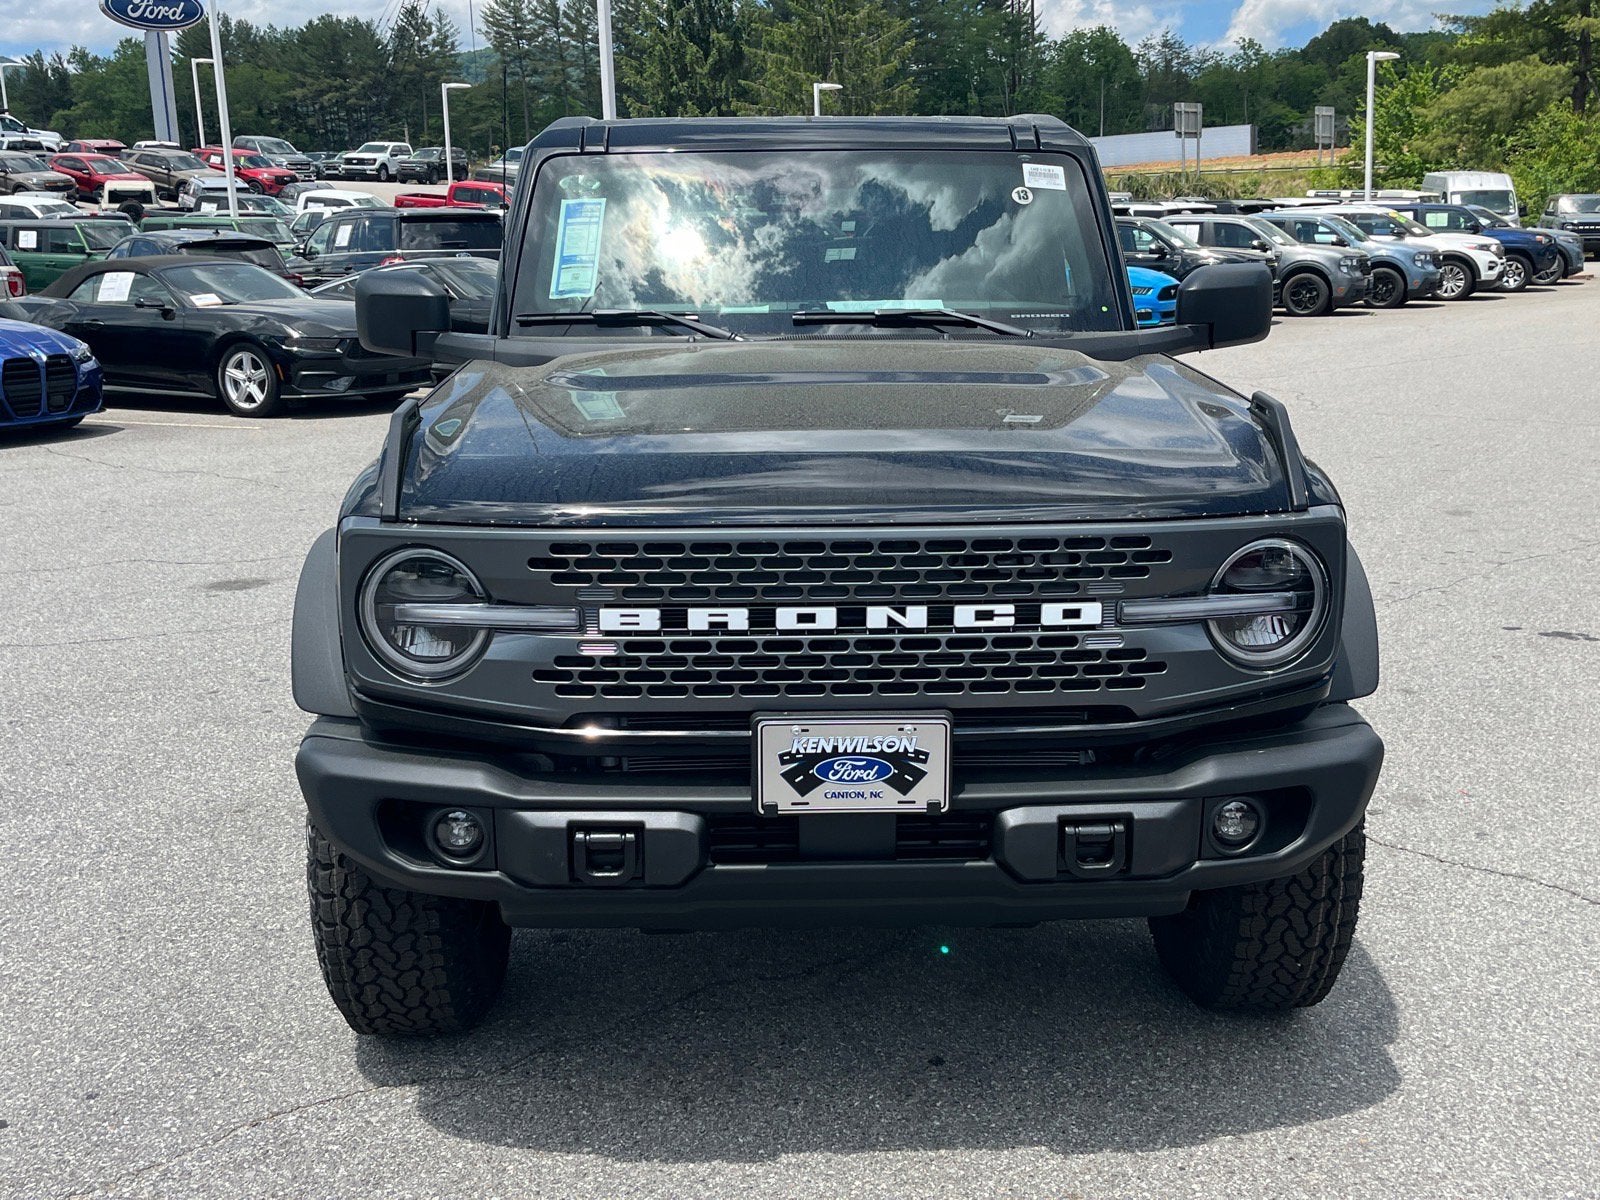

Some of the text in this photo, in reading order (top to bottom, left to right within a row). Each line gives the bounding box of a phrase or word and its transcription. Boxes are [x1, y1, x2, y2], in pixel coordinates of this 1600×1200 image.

[127, 0, 185, 20] Ford
[1015, 190, 1029, 201] 13
[599, 602, 1102, 632] BRONCO
[828, 759, 878, 781] Ford
[824, 790, 884, 799] CANTON, NC
